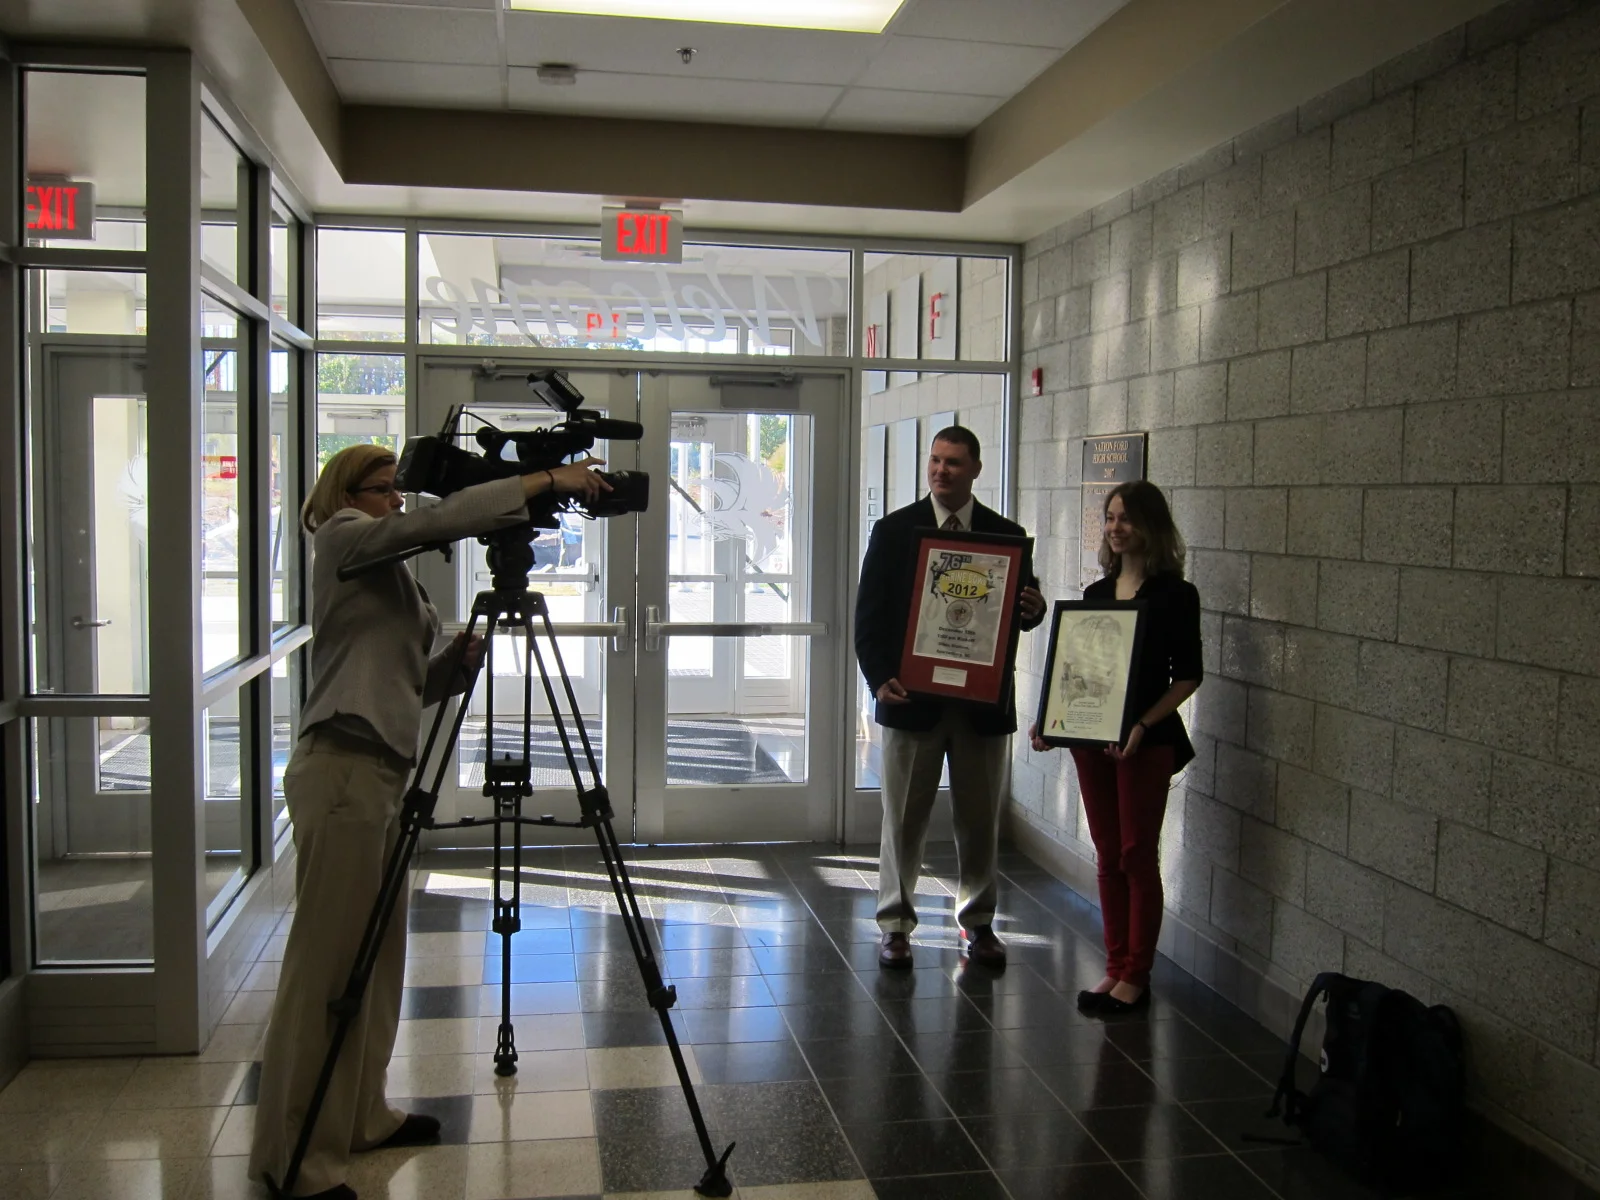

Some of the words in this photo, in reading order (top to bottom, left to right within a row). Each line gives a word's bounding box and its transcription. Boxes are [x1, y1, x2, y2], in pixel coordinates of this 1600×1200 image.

[616, 212, 672, 255] EXIT
[586, 312, 620, 338] ET
[1094, 441, 1113, 451] NATION
[1113, 440, 1129, 451] FORD
[1093, 453, 1106, 463] HIGH
[1106, 452, 1128, 463] SCHOOL
[948, 583, 978, 596] 2012
